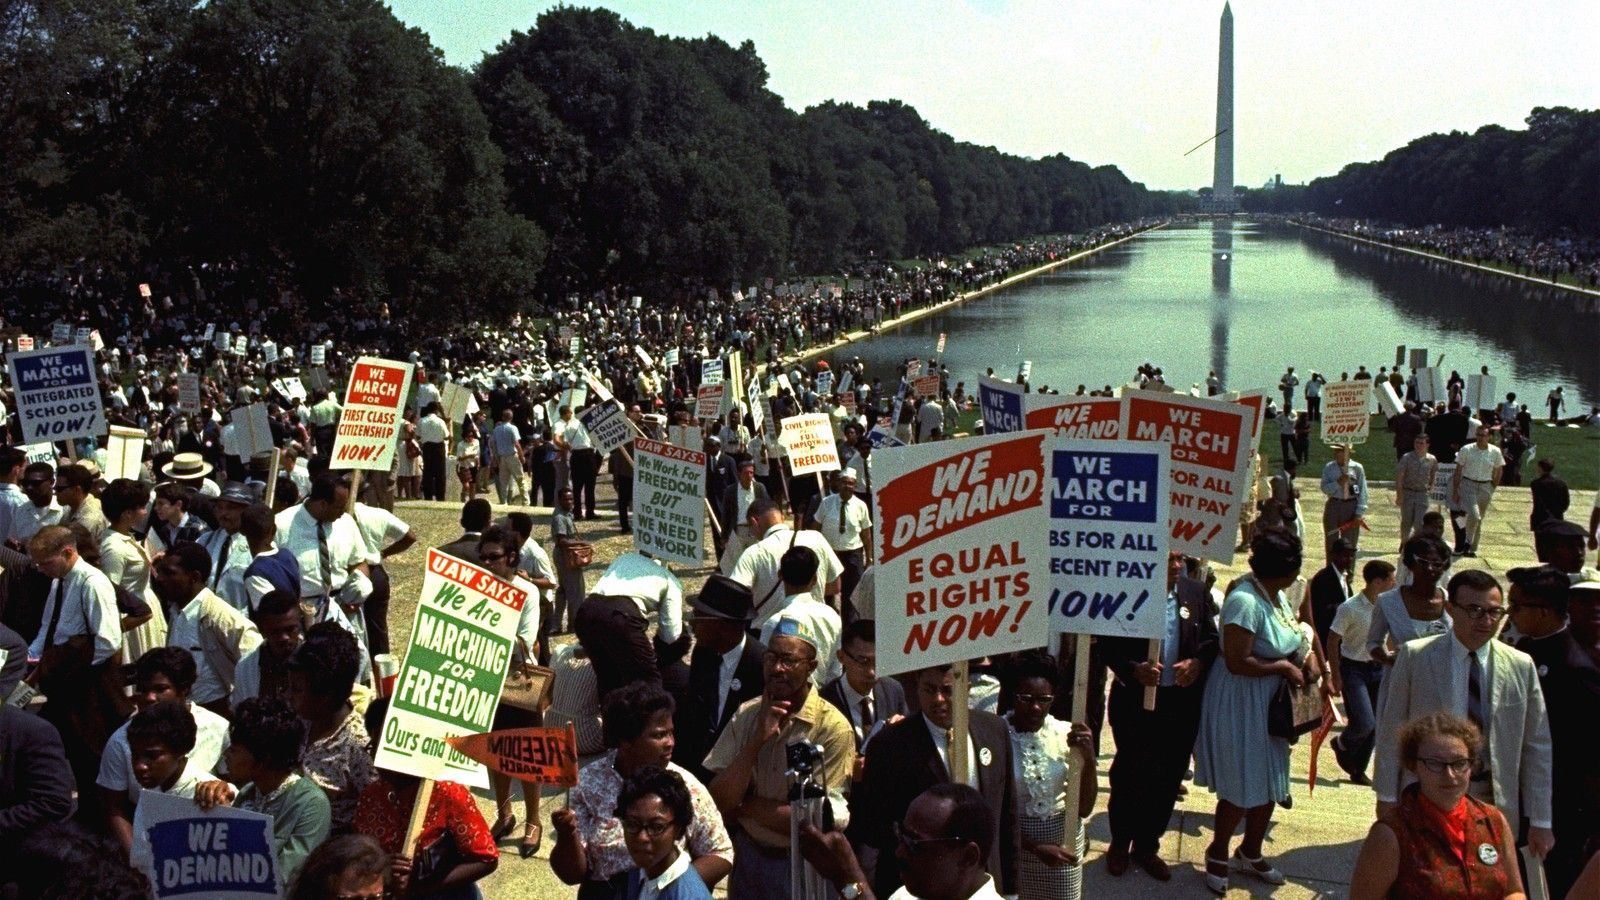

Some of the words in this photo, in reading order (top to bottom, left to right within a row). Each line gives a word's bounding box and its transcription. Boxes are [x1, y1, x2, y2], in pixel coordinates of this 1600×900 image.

[40, 356, 62, 366] WE
[23, 364, 84, 382] MARCH
[43, 378, 68, 386] FOR
[369, 368, 386, 380] WE
[22, 387, 94, 405] INTEGRATED
[353, 379, 398, 397] MARCH
[1329, 390, 1364, 398] CATHOLIC
[362, 395, 380, 404] FOR
[989, 391, 1004, 409] WE
[1327, 400, 1365, 408] PROTESTANT
[25, 401, 97, 419] SCHOOLS
[344, 409, 366, 421] FIRST
[367, 411, 396, 425] CLASS
[1054, 404, 1092, 426] WE
[1168, 407, 1200, 427] WE
[35, 414, 96, 437] NOW!
[338, 424, 394, 438] CITIZENSHIP
[594, 418, 623, 435] EQUAL
[598, 424, 628, 442] RIGHTS
[784, 422, 803, 430] CIVIL
[1327, 422, 1365, 434] NOW!
[604, 428, 631, 450] NOW!
[1136, 420, 1230, 455] MARCH
[337, 444, 386, 462] NOW!
[638, 440, 663, 454] UAW
[664, 447, 704, 464] SAYS:
[793, 454, 836, 468] FREEDOM
[1173, 449, 1200, 462] OR
[638, 454, 652, 470] We
[652, 458, 680, 476] Work
[682, 466, 701, 481] For
[932, 450, 992, 498] WE
[1072, 456, 1112, 475] WE
[1170, 469, 1199, 488] OR
[1203, 476, 1233, 496] ALL
[650, 492, 682, 509] BUT
[890, 468, 1038, 549] DEMAND
[1198, 498, 1231, 517] PAY
[641, 504, 652, 514] TO
[654, 510, 666, 520] BE
[670, 512, 694, 527] FREE
[1068, 504, 1112, 518] FOR
[638, 514, 655, 531] WE
[658, 520, 698, 543] NEED
[637, 529, 652, 545] TO
[655, 534, 697, 560] WORK
[1076, 531, 1116, 550] FOR
[1120, 534, 1158, 552] ALL
[908, 540, 1027, 584] EQUAL
[1050, 558, 1112, 578] ECENT
[1116, 561, 1158, 580] PAY
[432, 556, 477, 584] UAW
[476, 574, 525, 607] SAYS:
[434, 582, 466, 610] We
[468, 598, 502, 627] Are
[906, 572, 1031, 617] RIGHTS
[903, 600, 1034, 654] NOW!
[415, 612, 507, 675] MARCHING
[438, 660, 476, 682] FOR
[400, 665, 496, 728] FREEDOM
[386, 716, 420, 751] Ours
[422, 733, 448, 758] and
[188, 822, 229, 852] WE
[163, 853, 270, 889] DEMAND
